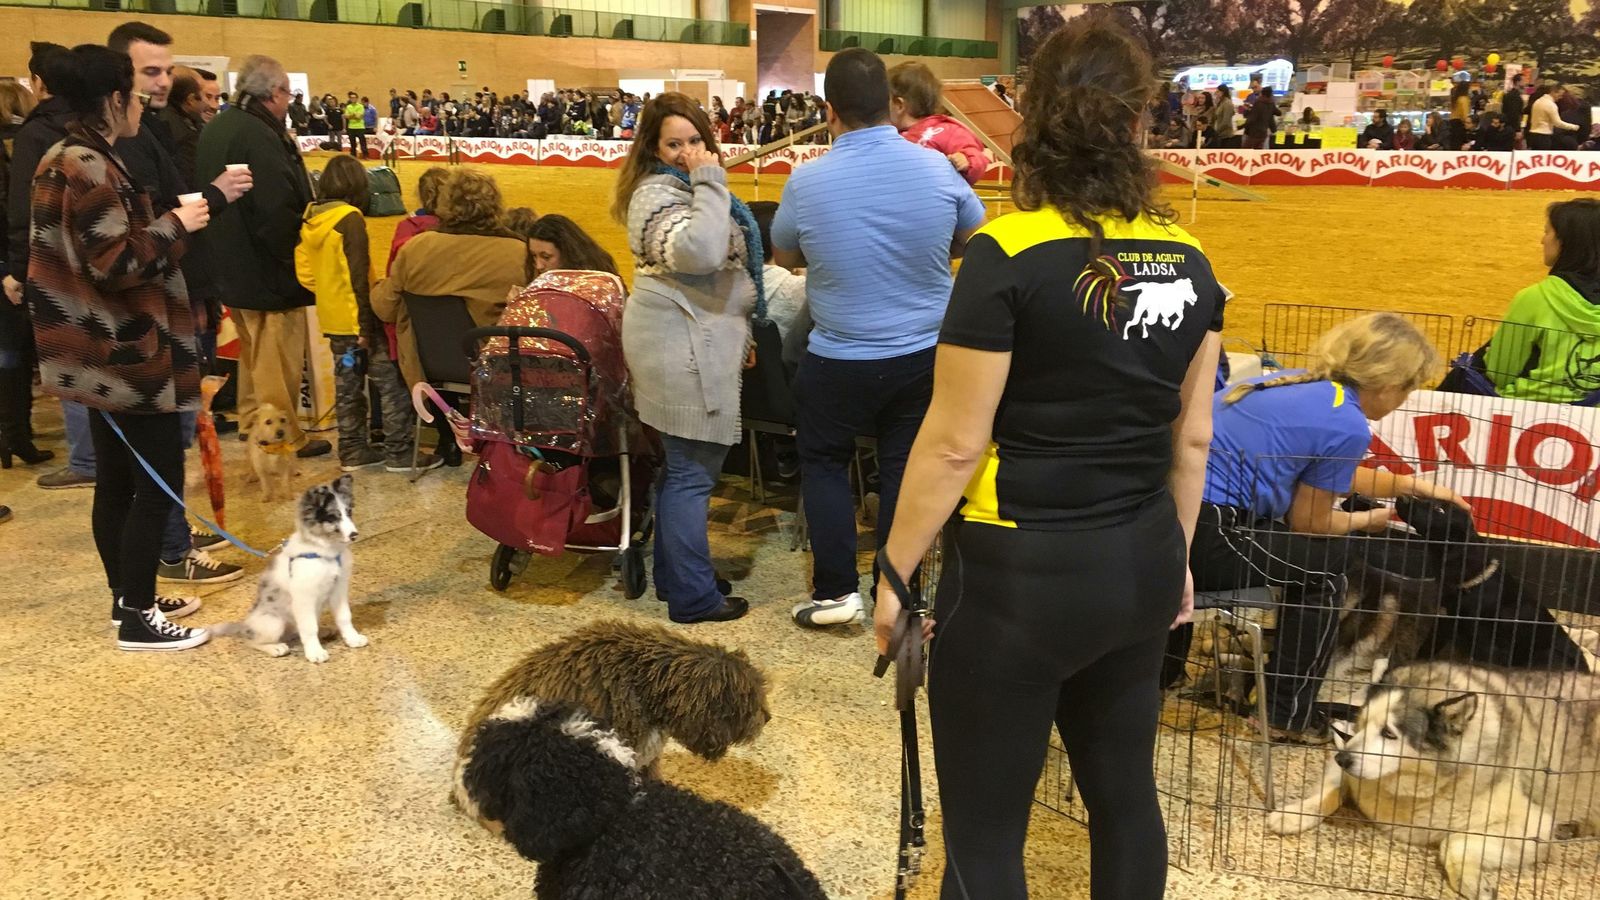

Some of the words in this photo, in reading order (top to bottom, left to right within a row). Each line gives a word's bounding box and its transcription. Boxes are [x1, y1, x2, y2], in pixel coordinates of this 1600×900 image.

[474, 140, 503, 154] ARION
[505, 141, 535, 155] ARION
[542, 142, 572, 156] ARION
[575, 143, 607, 157] ARION
[721, 147, 750, 159] ARIO
[1195, 152, 1248, 171] ARION
[1250, 152, 1306, 172] ARION
[1310, 152, 1370, 172] ARION
[1376, 154, 1437, 174] ARION
[1442, 155, 1506, 175] ARION
[1516, 154, 1582, 175] ARION
[1117, 252, 1141, 262] CLUB
[1142, 253, 1154, 262] DE
[1155, 253, 1185, 263] AGILITY
[1133, 262, 1177, 276] LADSA
